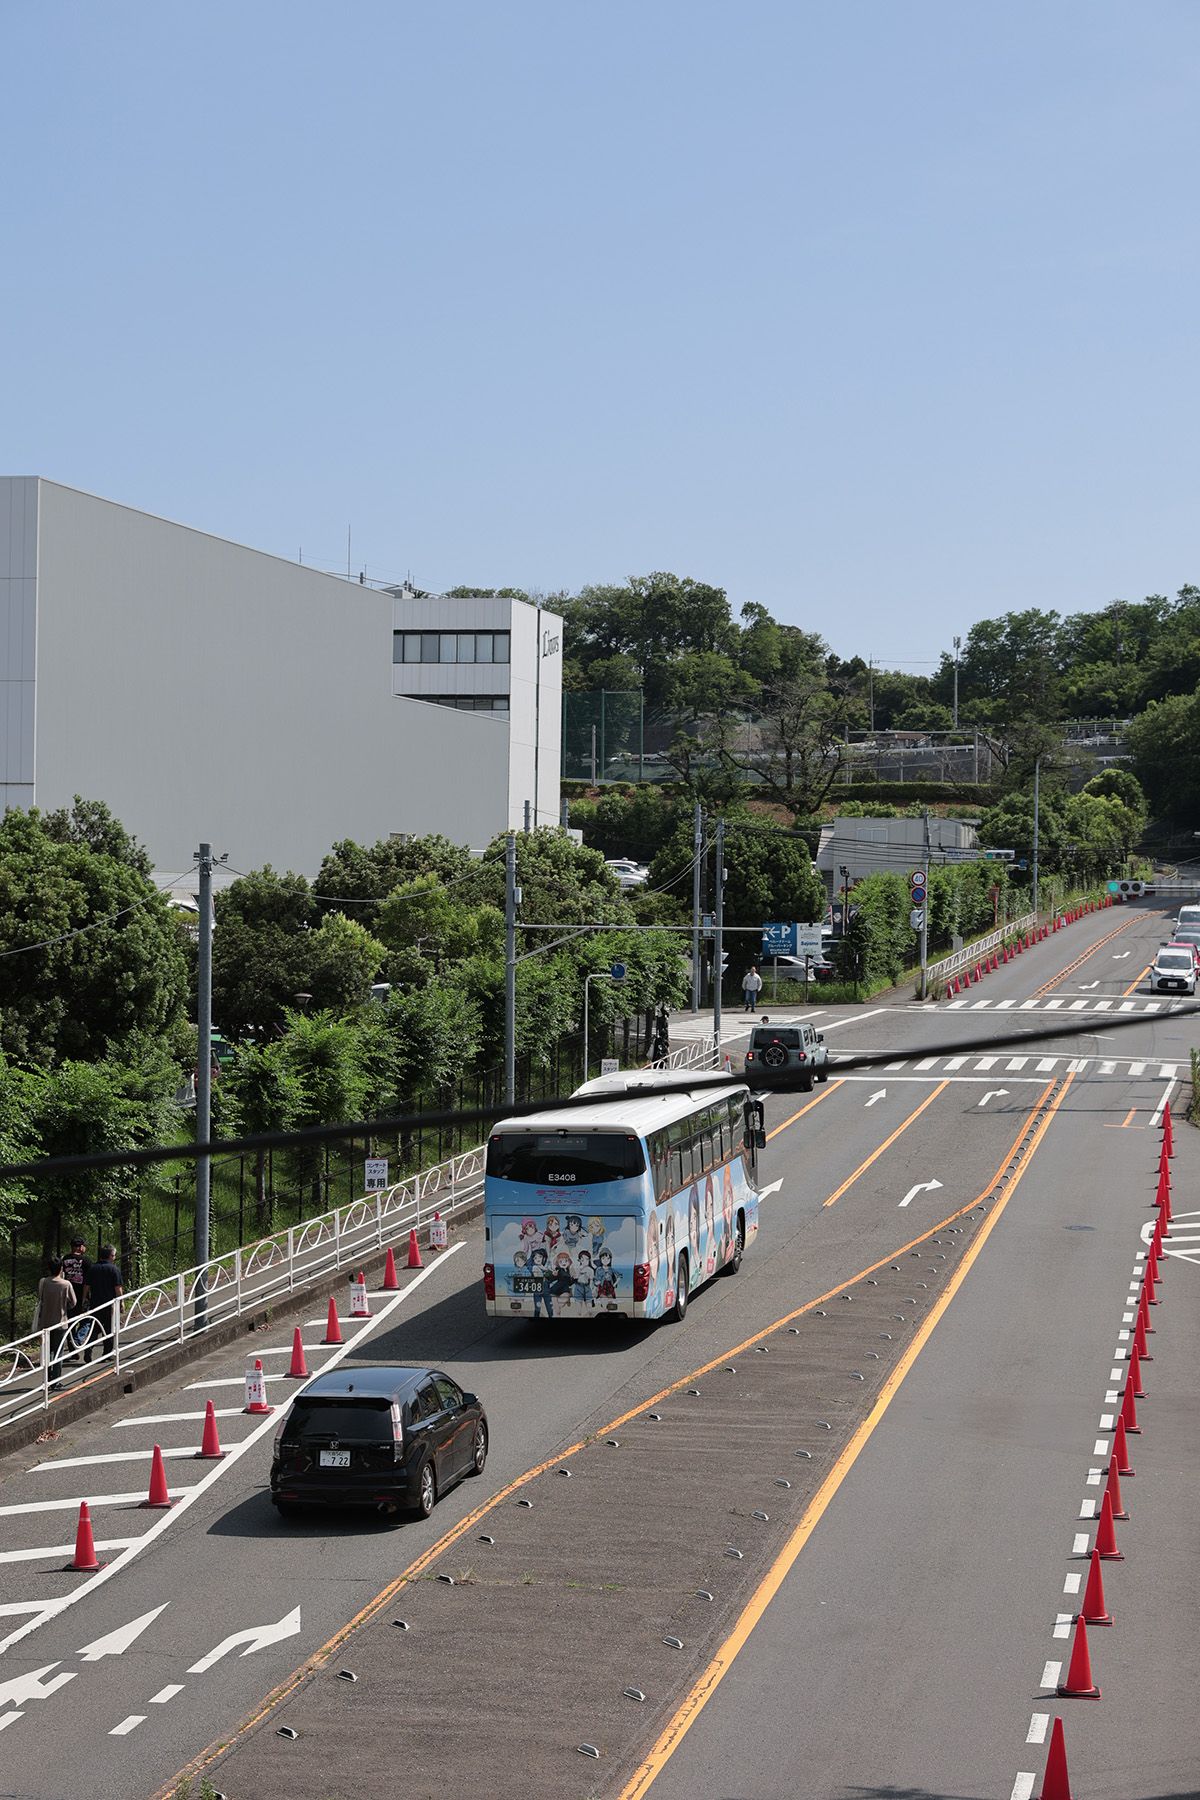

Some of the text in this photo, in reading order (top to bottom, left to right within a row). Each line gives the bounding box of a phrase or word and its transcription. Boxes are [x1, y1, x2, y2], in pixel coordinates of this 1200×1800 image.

[781, 925, 791, 938] P
[548, 1173, 576, 1181] E3408
[367, 1179, 385, 1188] 専用
[518, 1282, 542, 1292] 34-08
